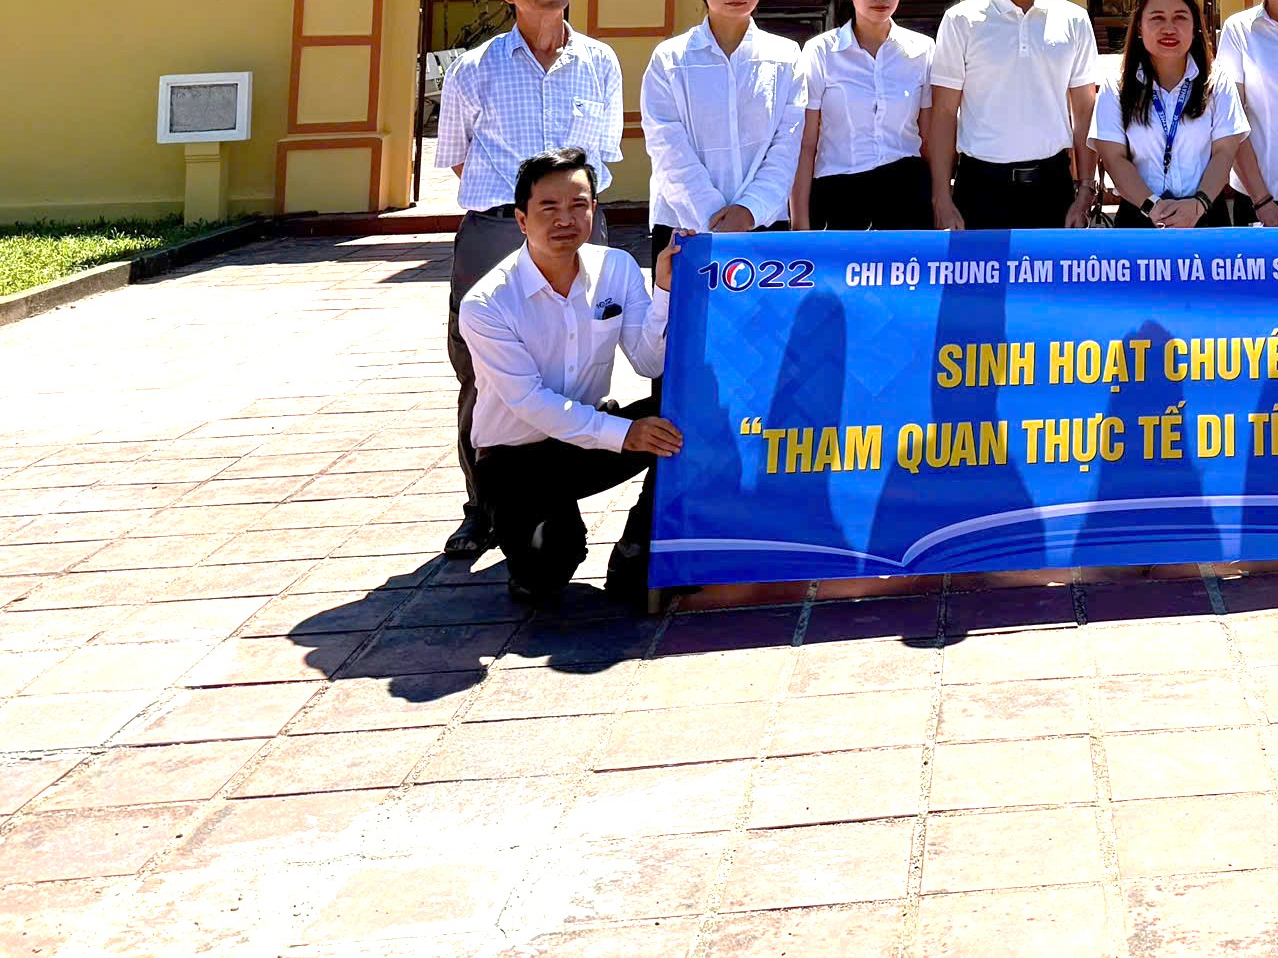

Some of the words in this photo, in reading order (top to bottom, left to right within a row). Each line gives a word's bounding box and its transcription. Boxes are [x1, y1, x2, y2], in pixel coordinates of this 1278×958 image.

[698, 258, 814, 292] 1022
[846, 263, 882, 286] CHI
[890, 258, 919, 290] BỘ
[928, 261, 999, 284] TRUNG
[1007, 256, 1052, 282] TÂM
[1061, 256, 1130, 281] THÔNG
[1137, 260, 1170, 280] TIN
[1178, 255, 1204, 280] VÀ
[1212, 254, 1265, 280] GIÁM
[938, 342, 1034, 387] SINH
[1049, 340, 1150, 392] HOẠT
[740, 417, 882, 473] “THAM
[898, 421, 1007, 473] QUAN
[1022, 413, 1124, 471] THỰC
[1139, 401, 1185, 459] TẾ
[1198, 414, 1234, 457] DI
